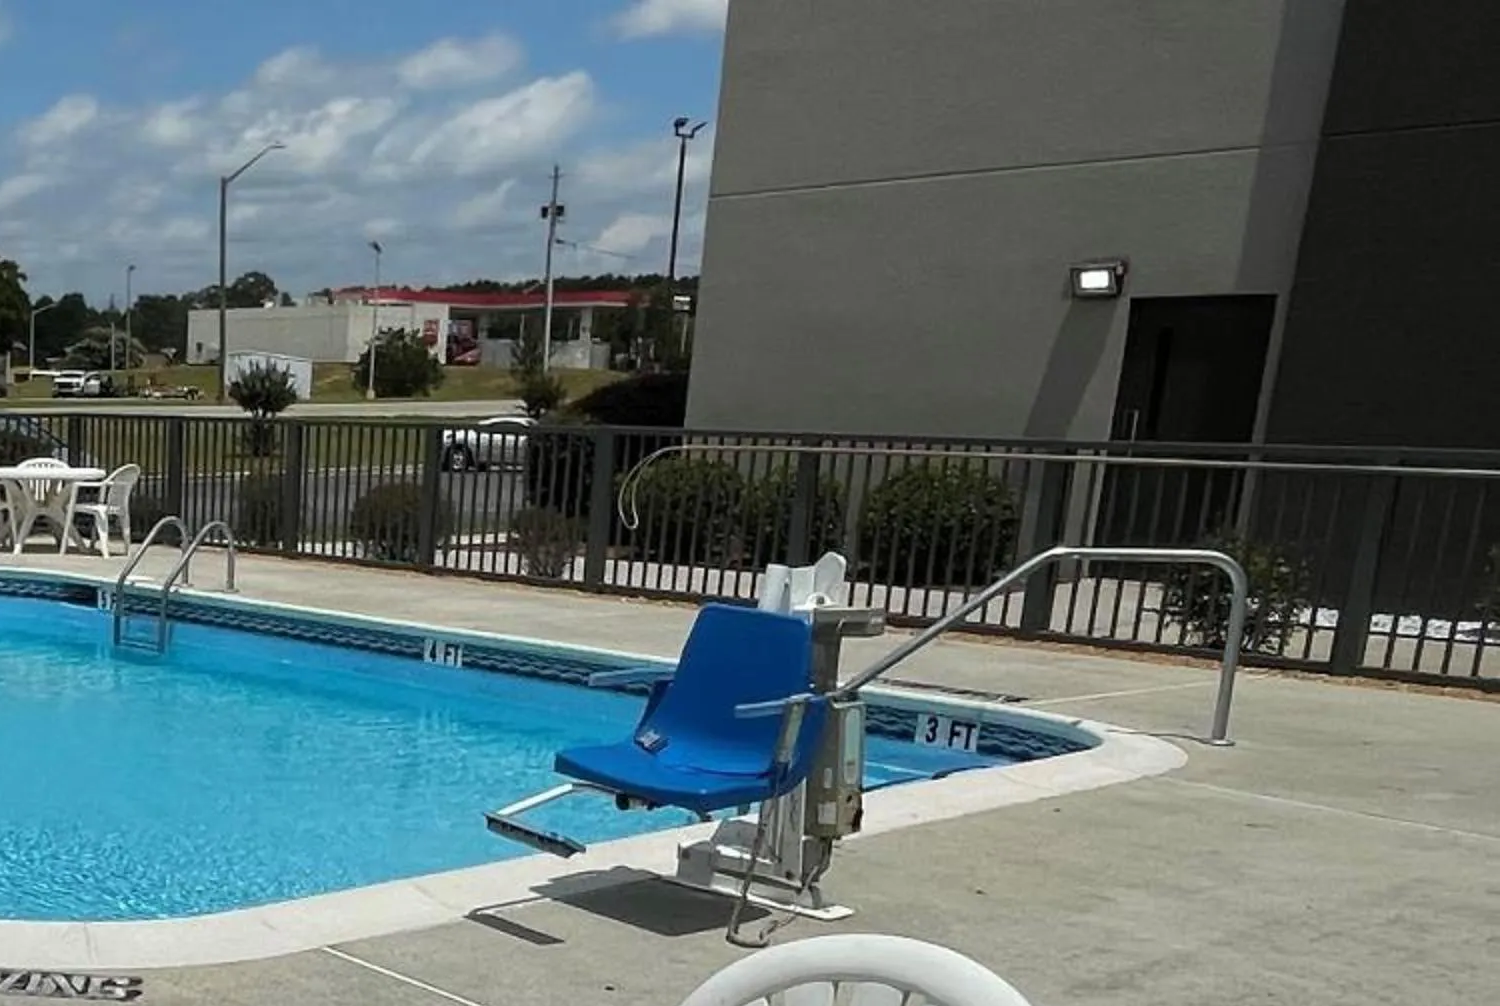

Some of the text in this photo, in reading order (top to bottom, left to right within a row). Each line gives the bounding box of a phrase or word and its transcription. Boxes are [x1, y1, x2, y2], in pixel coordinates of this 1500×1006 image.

[428, 640, 438, 663] 4
[925, 716, 978, 750] 3 FT
